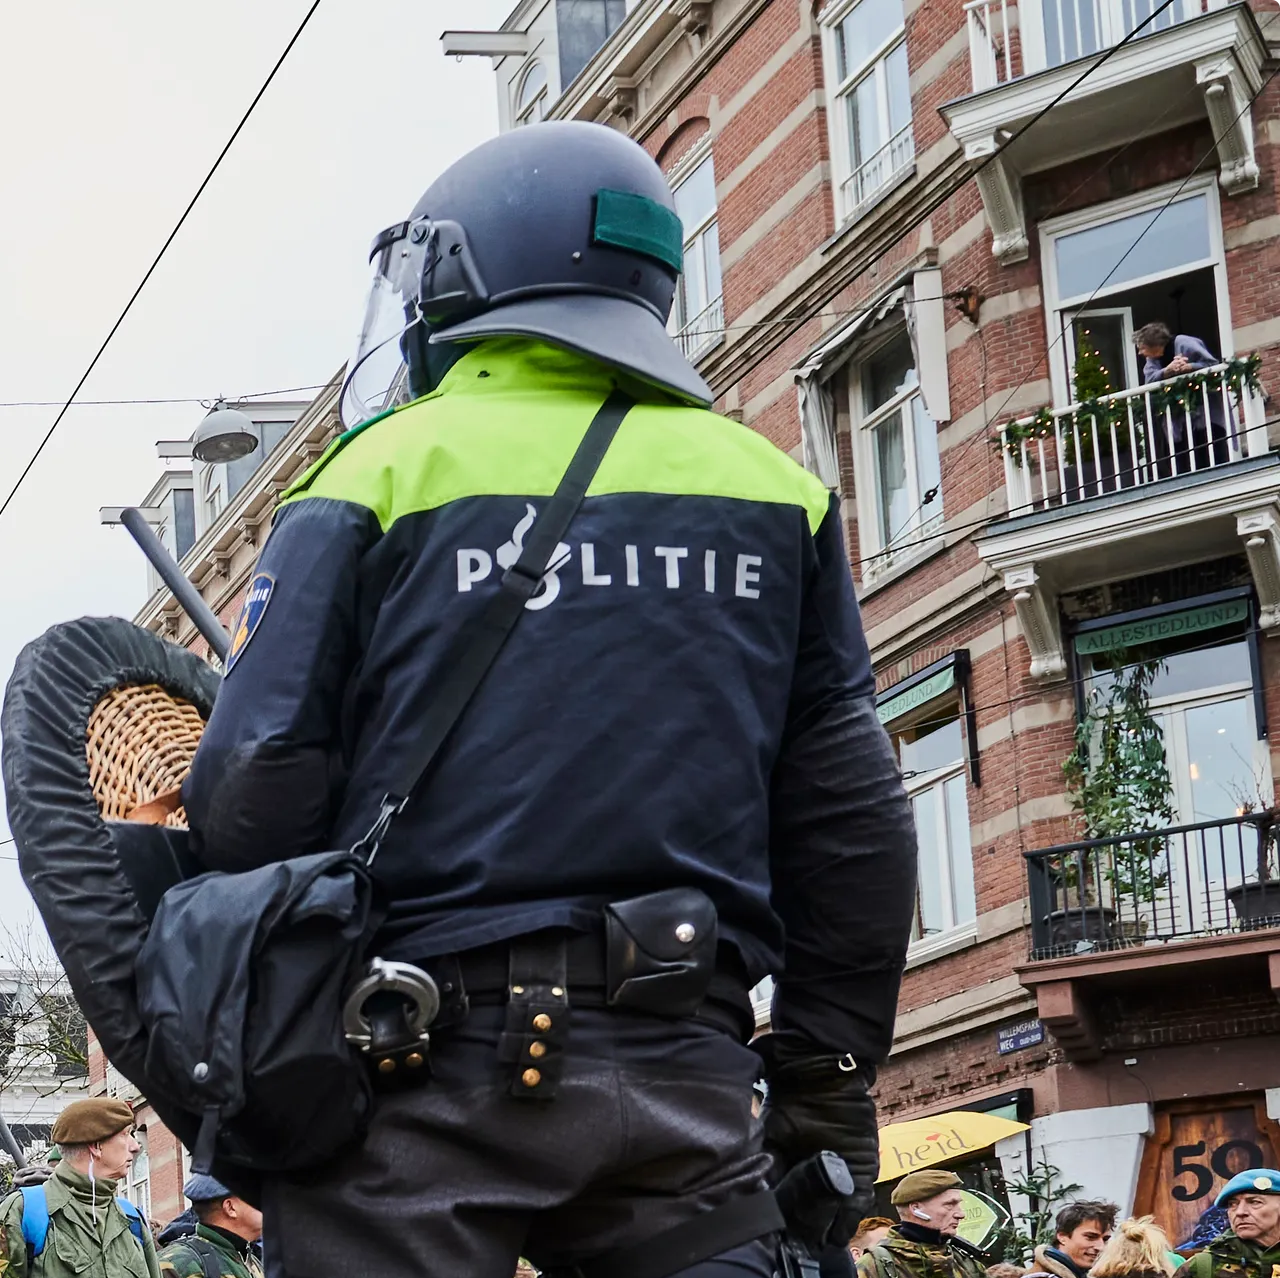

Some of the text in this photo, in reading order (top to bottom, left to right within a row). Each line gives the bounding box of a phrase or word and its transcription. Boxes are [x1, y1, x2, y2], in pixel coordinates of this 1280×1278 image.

[1087, 605, 1240, 650] ALLESTEDLUND
[877, 682, 933, 721] STEDLUND
[999, 1019, 1040, 1040] WILLEMSPARK
[1000, 1038, 1014, 1051] WEG
